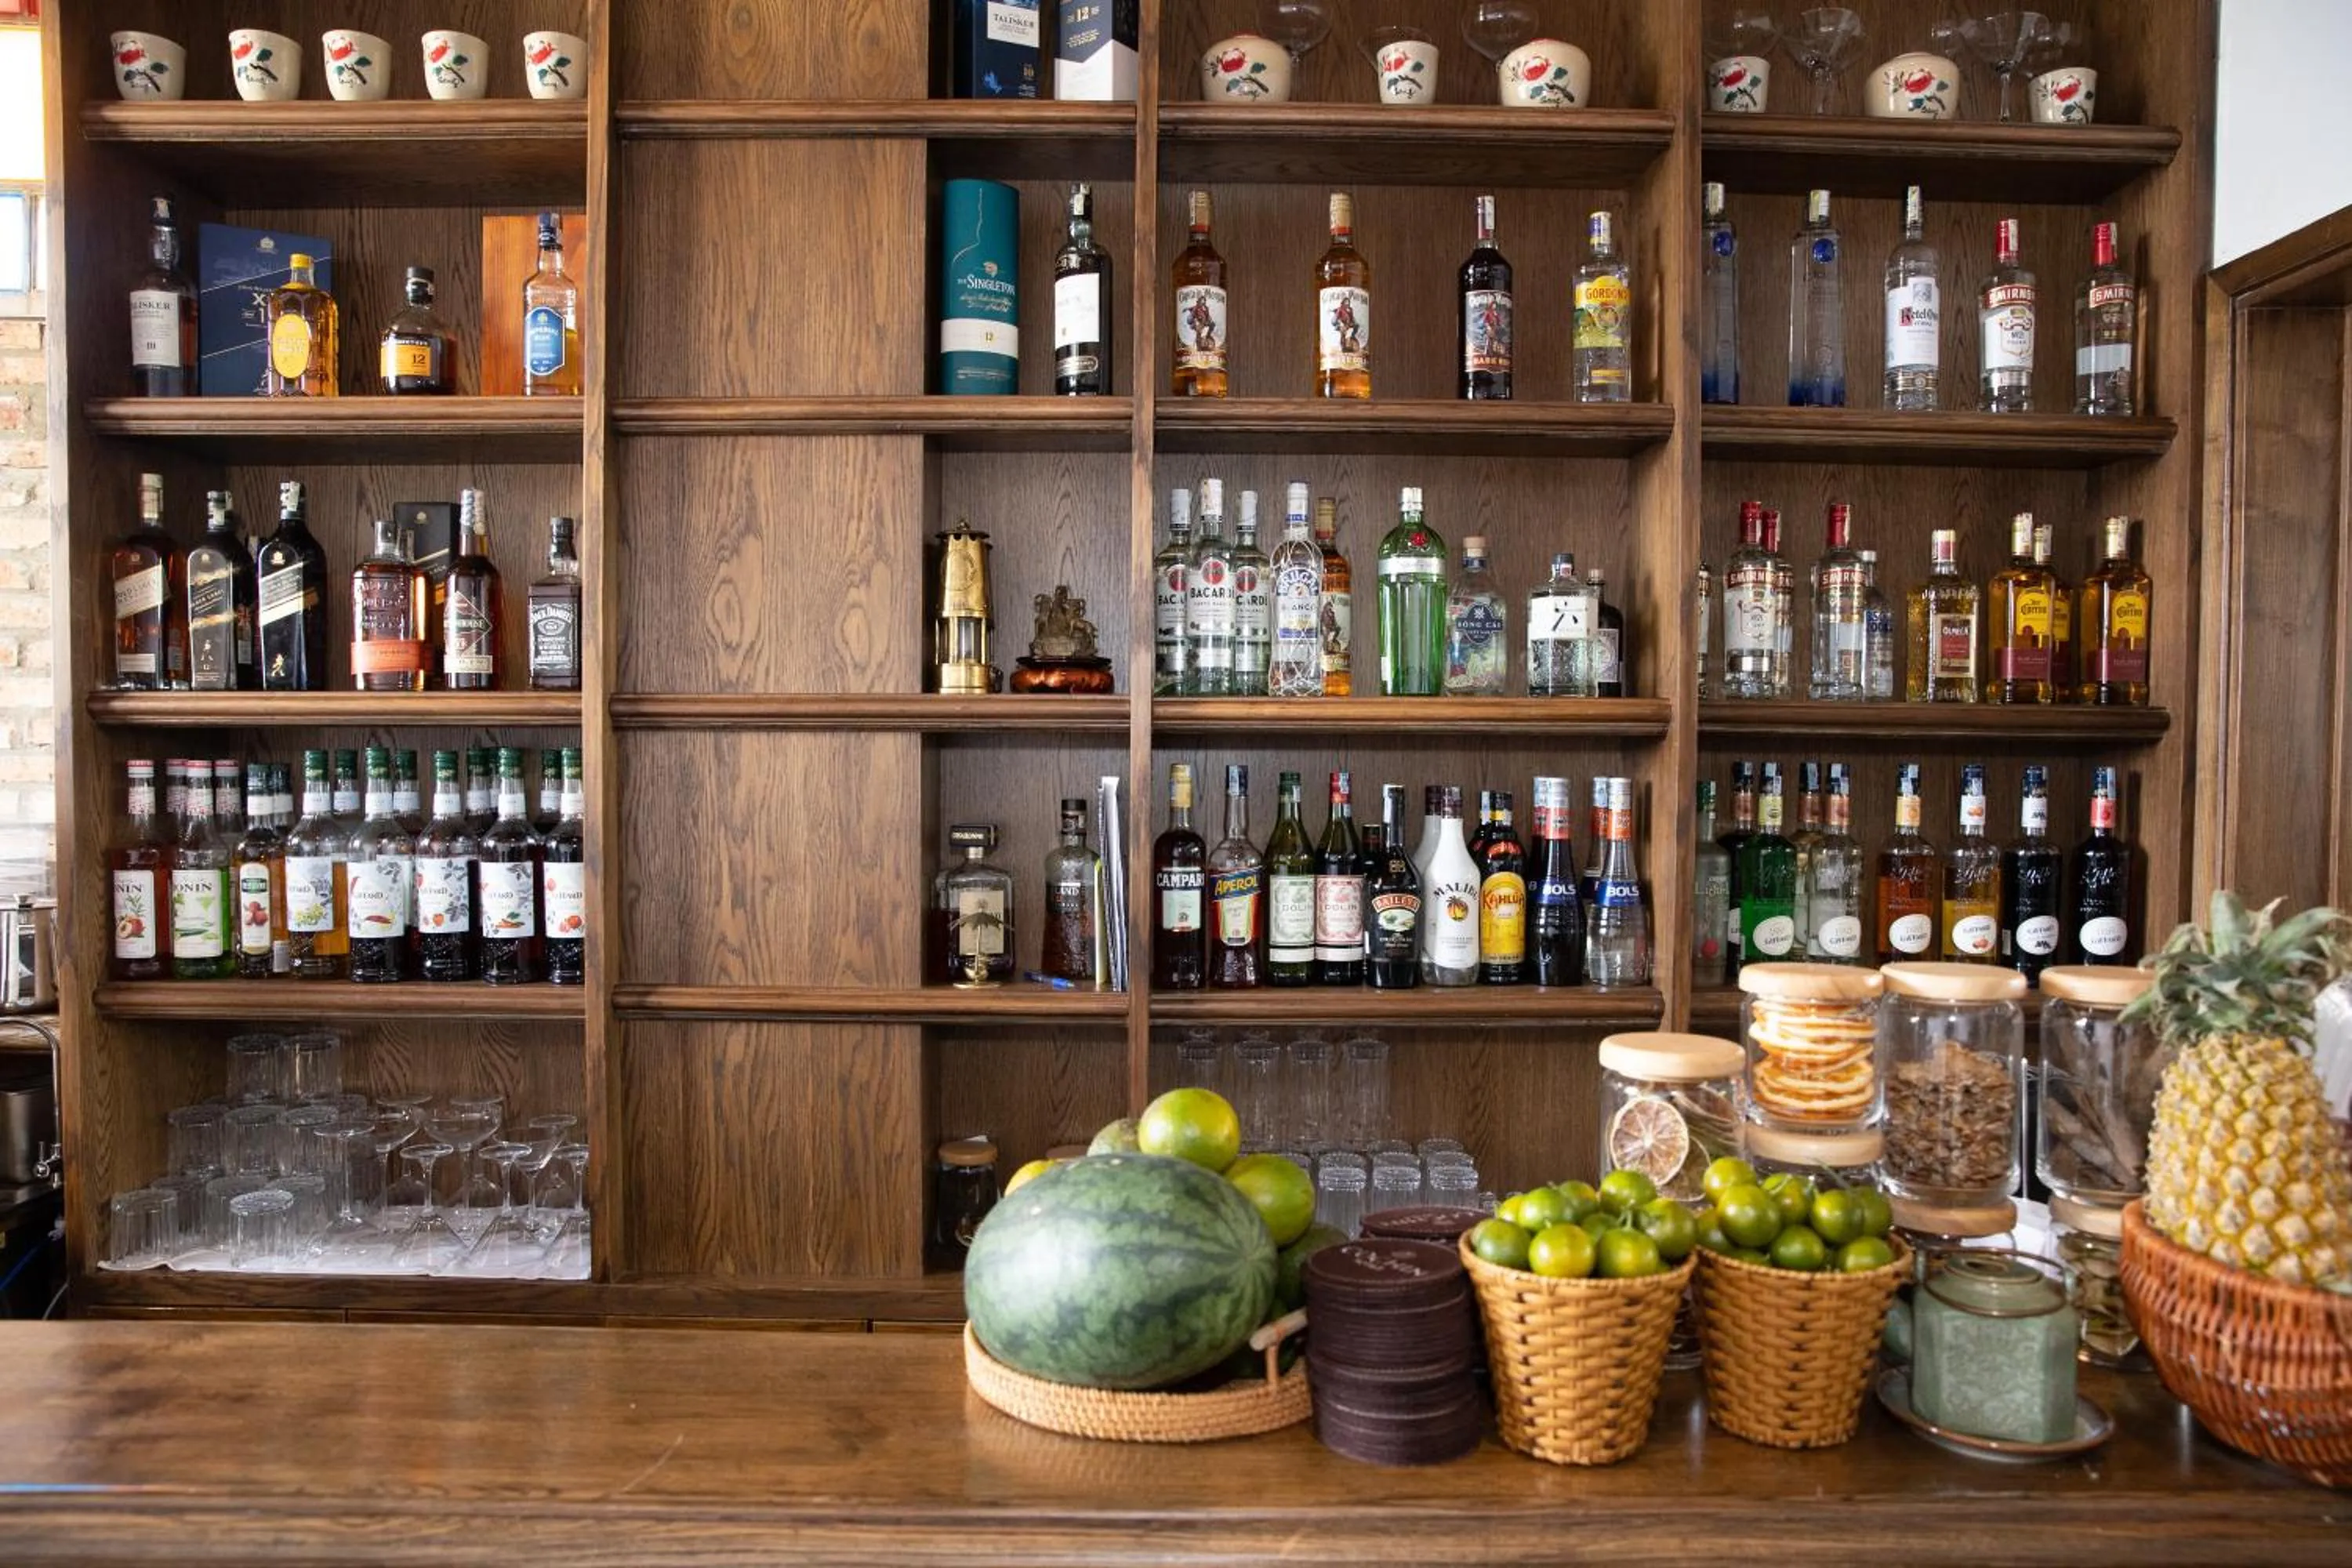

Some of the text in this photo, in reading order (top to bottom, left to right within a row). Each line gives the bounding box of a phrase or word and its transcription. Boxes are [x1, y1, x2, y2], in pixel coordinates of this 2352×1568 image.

[993, 13, 1034, 27] TALISKER
[967, 274, 1015, 296] SINGLETON
[413, 354, 426, 365] 12
[1215, 875, 1258, 895] APEROL
[1543, 884, 1577, 895] BOLS
[1606, 885, 1639, 896] BOLS
